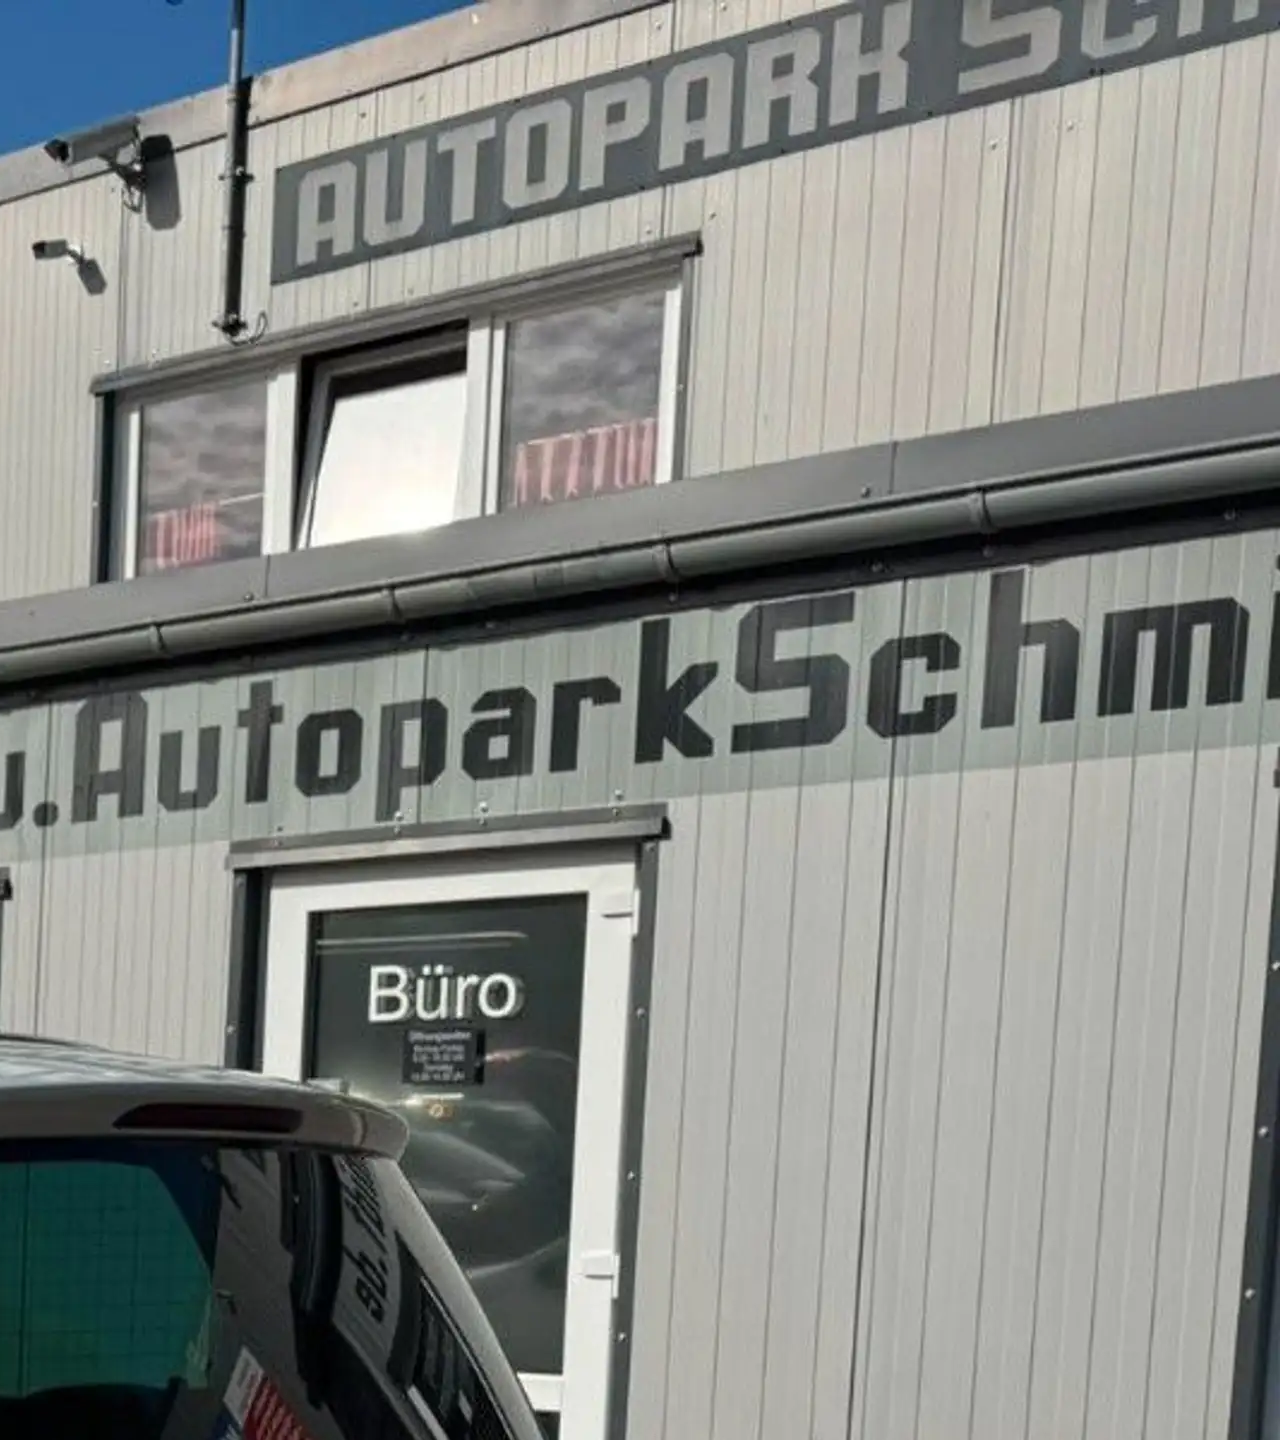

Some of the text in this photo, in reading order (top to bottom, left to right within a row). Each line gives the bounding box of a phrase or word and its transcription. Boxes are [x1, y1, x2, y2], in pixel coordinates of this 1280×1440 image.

[295, 0, 1260, 266] AUTOPARK Sc
[367, 963, 518, 1024] Büro
